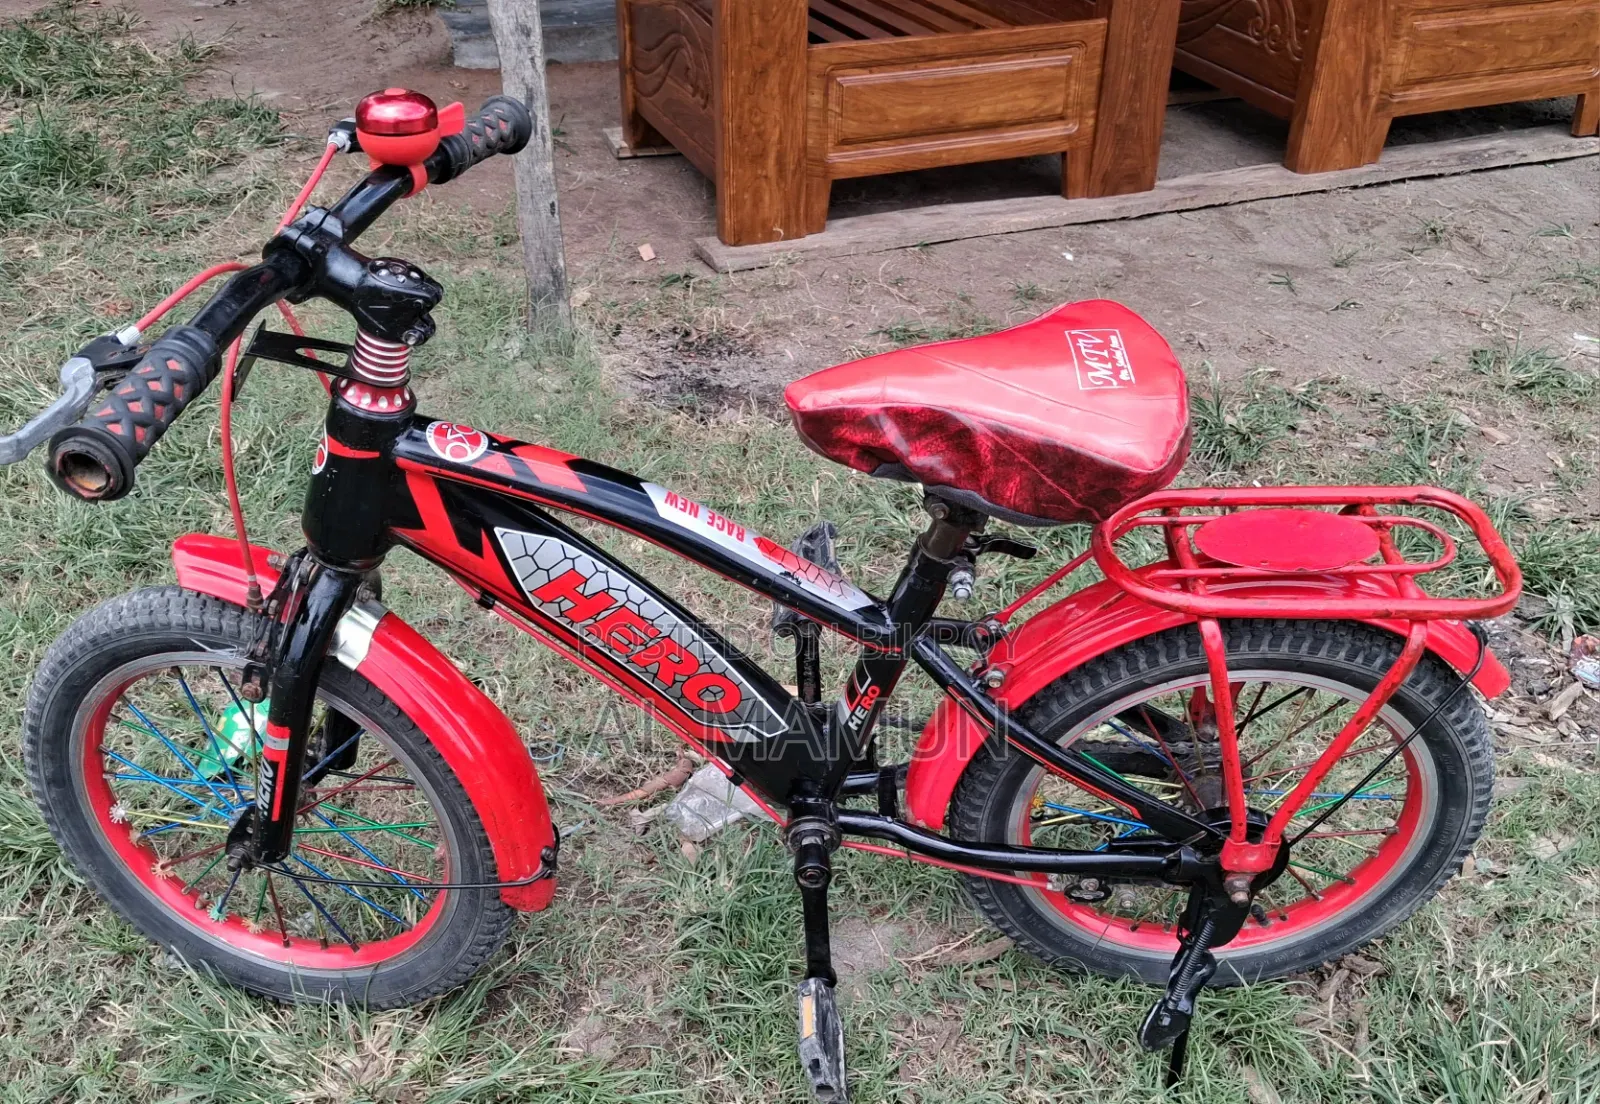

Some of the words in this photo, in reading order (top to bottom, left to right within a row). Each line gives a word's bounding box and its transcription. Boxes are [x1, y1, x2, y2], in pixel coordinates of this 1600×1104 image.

[1071, 330, 1118, 387] MTV
[663, 490, 700, 519] NEW
[706, 509, 746, 543] RACE
[530, 568, 742, 714] HERO
[847, 685, 881, 731] HERO
